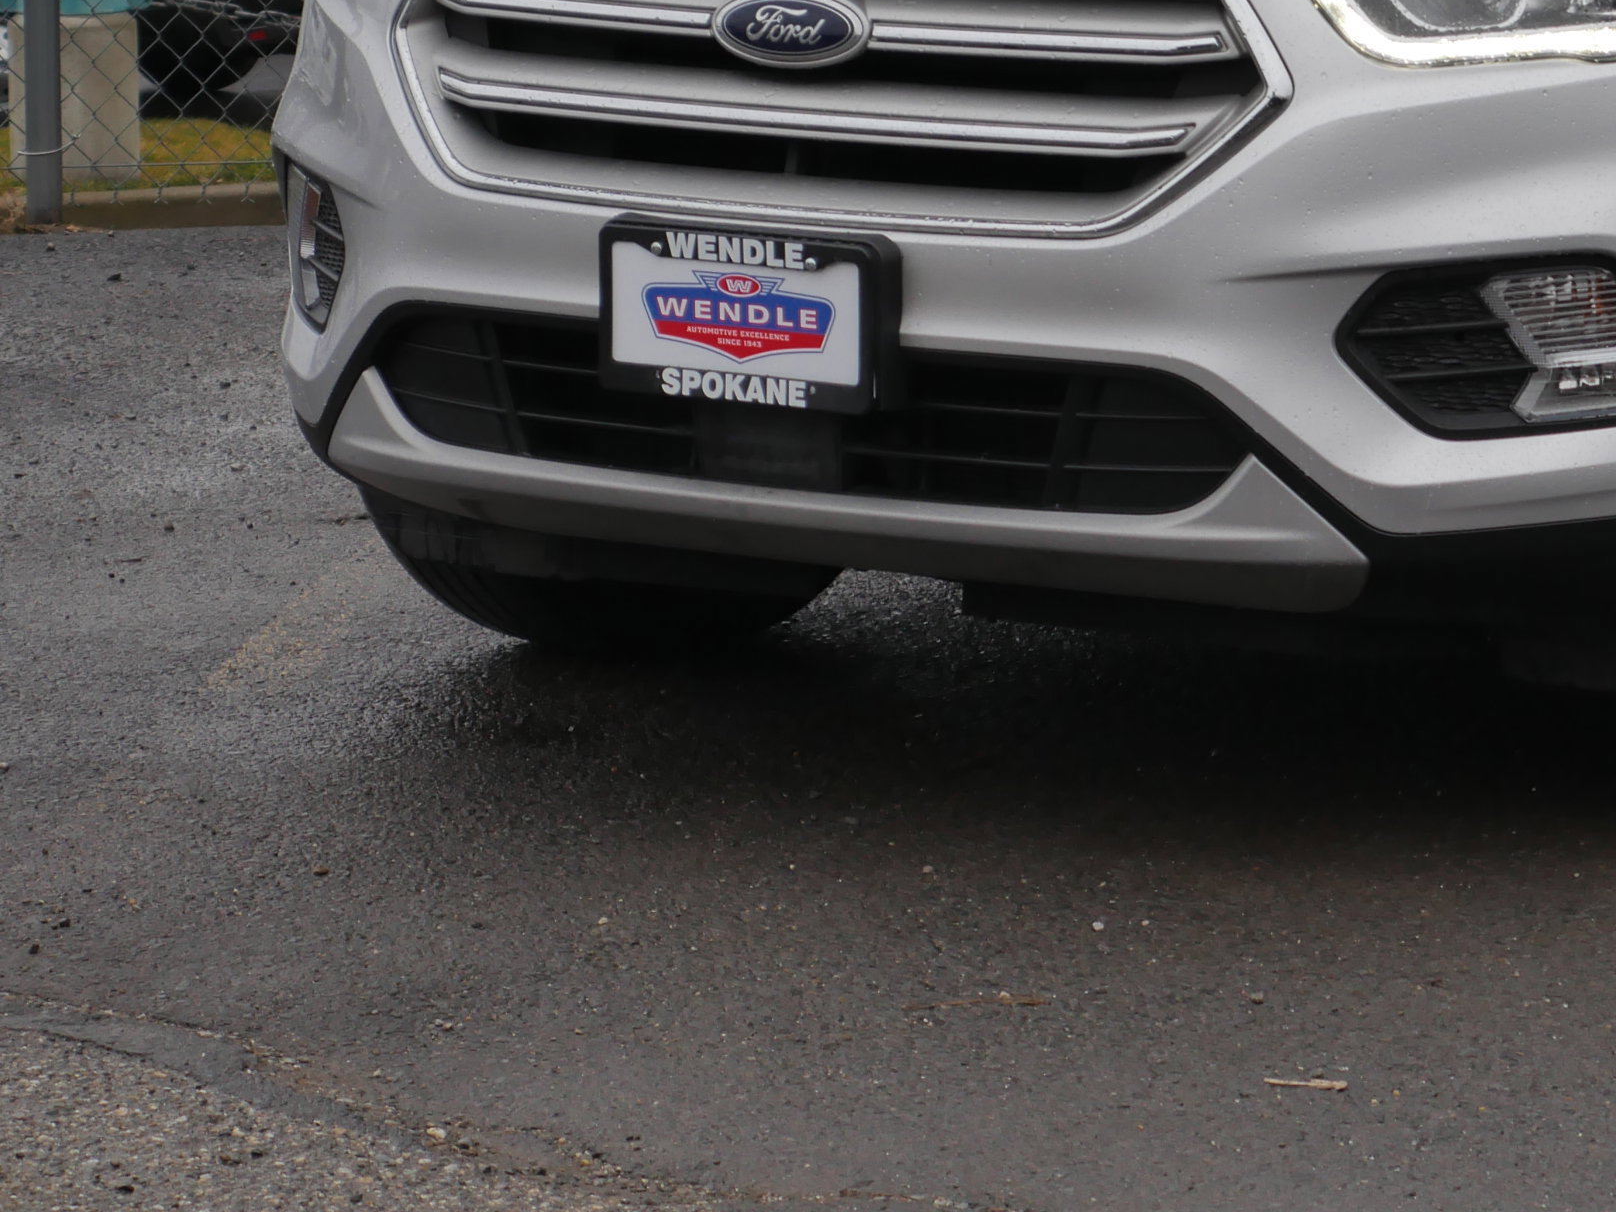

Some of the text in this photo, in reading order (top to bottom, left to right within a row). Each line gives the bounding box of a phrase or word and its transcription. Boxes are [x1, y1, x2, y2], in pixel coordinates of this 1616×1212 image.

[746, 4, 826, 46] Ford
[665, 231, 806, 270] WENDLE
[656, 296, 818, 330] WENDLE
[686, 325, 791, 342] AUTOMOTIVE EXCELLENCE
[717, 337, 763, 349] SINCE 1943
[661, 366, 807, 409] SPOKANE
